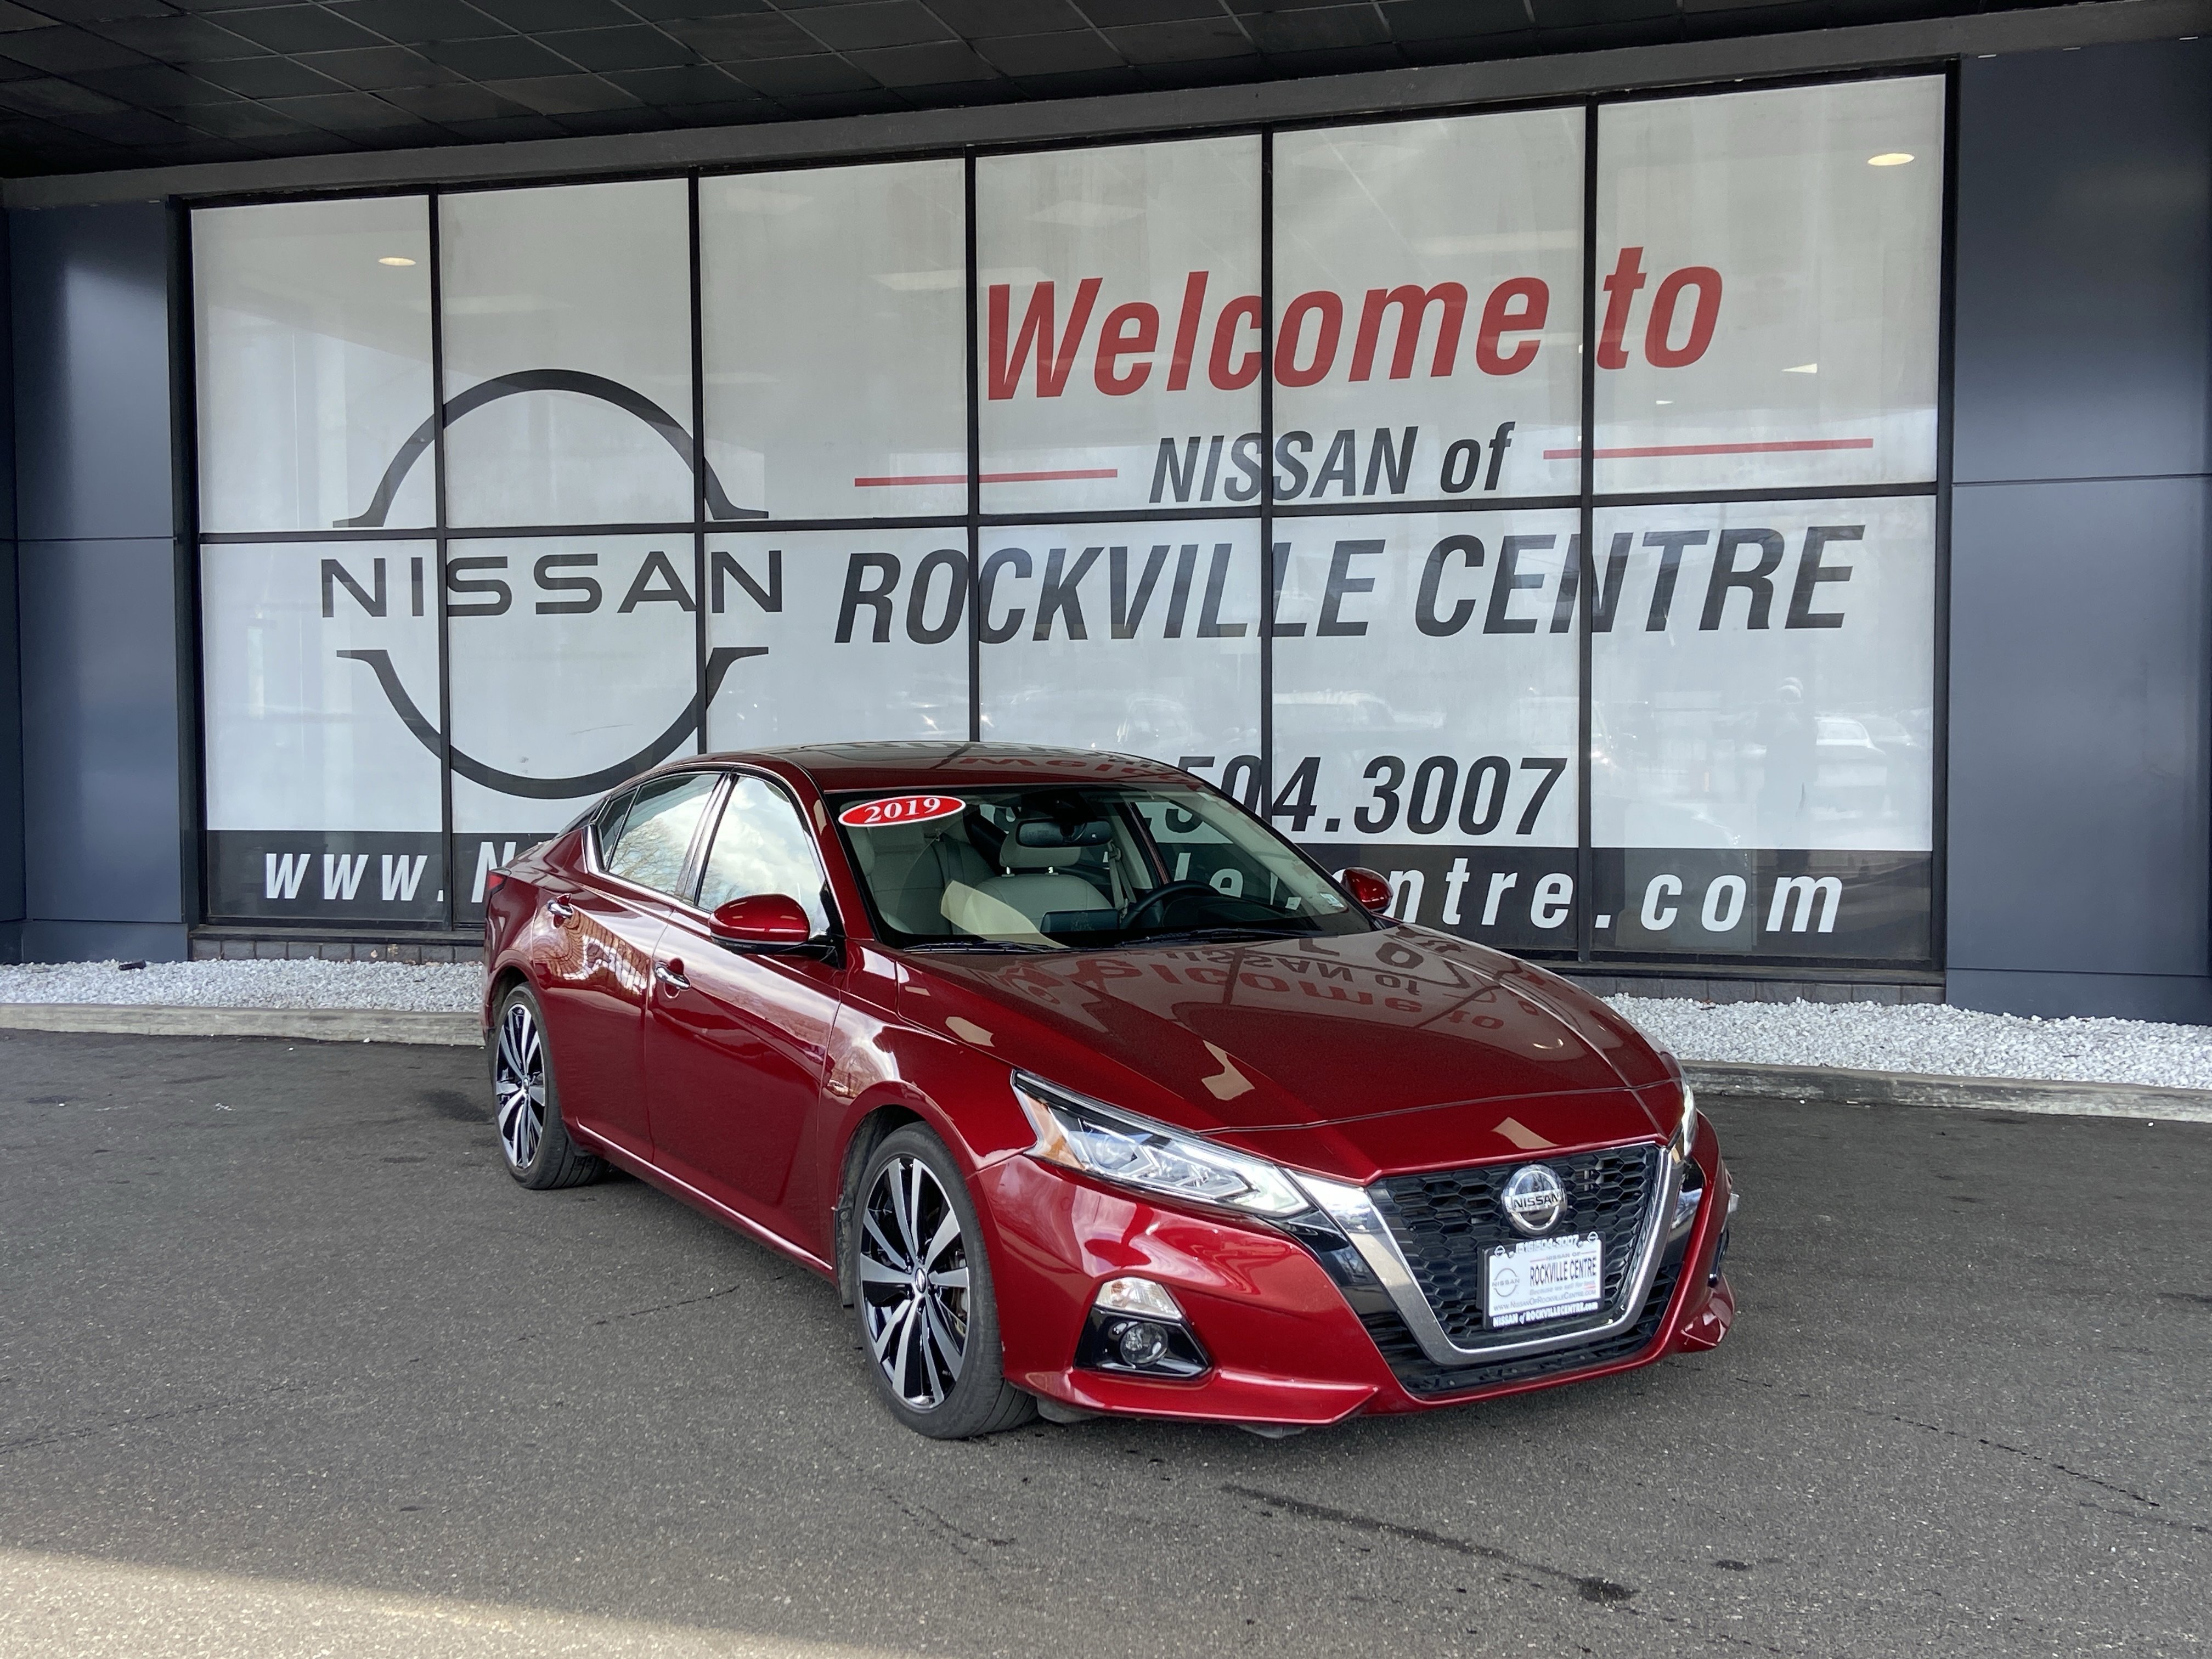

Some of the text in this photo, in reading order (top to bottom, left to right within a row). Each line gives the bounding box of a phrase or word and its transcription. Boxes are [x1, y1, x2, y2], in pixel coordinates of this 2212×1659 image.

[988, 247, 1723, 400] Welcome to
[1149, 421, 1515, 503] NISSAN of
[321, 550, 782, 618] NISSAN
[836, 524, 1866, 644] ROCKVILLE CENTRE
[864, 797, 941, 824] 2019
[1332, 856, 1842, 934] ntre.com
[1514, 1193, 1559, 1208] NISSAN
[1492, 1278, 1520, 1287] NISSAN
[1530, 1256, 1596, 1286] ROCKVILLE CENTRE
[1493, 1313, 1519, 1328] NISSAN
